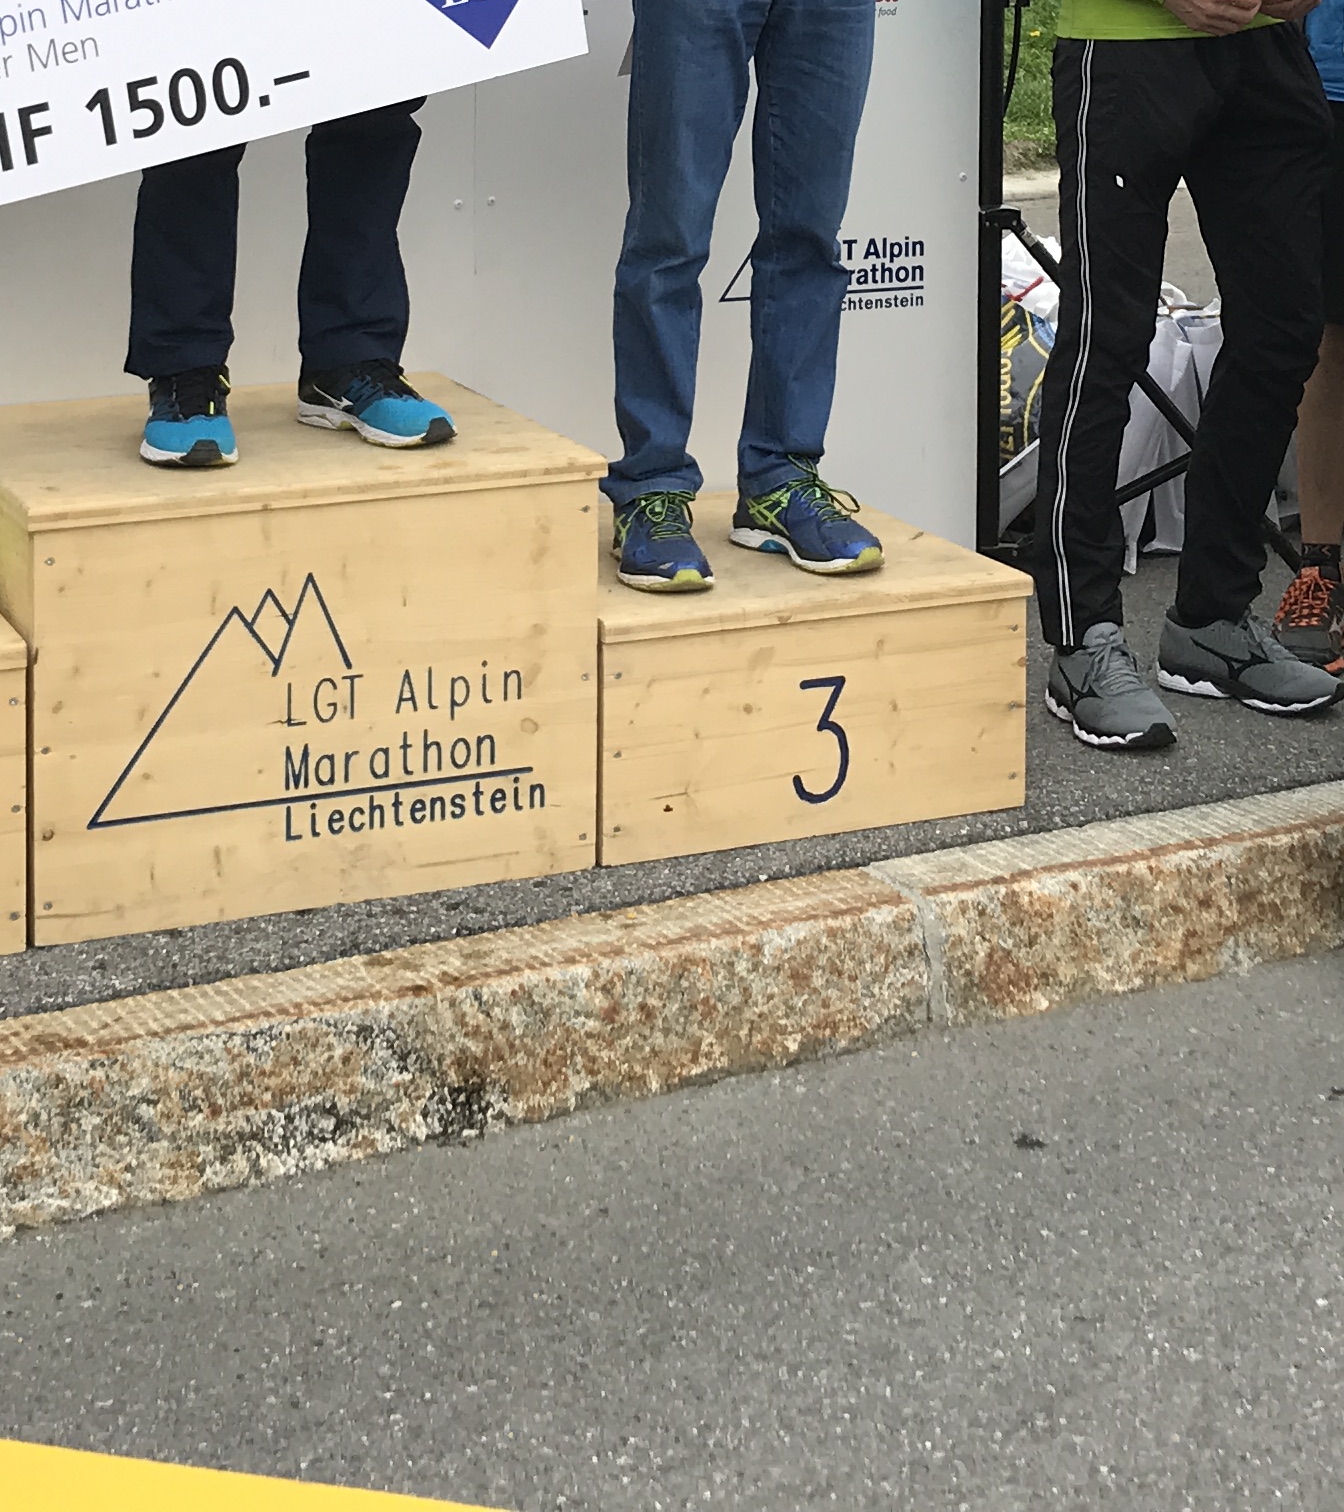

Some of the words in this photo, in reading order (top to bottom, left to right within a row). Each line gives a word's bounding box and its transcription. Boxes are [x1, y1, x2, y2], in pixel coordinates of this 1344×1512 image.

[28, 35, 100, 71] Men
[863, 236, 925, 263] Alpin
[847, 264, 925, 285] rathon
[841, 293, 925, 311] chtenstein
[285, 674, 363, 728] LGT
[396, 660, 524, 719] Alpin
[284, 728, 497, 791] Marathon
[792, 676, 850, 804] 3
[285, 776, 547, 841] Liechtenstein
